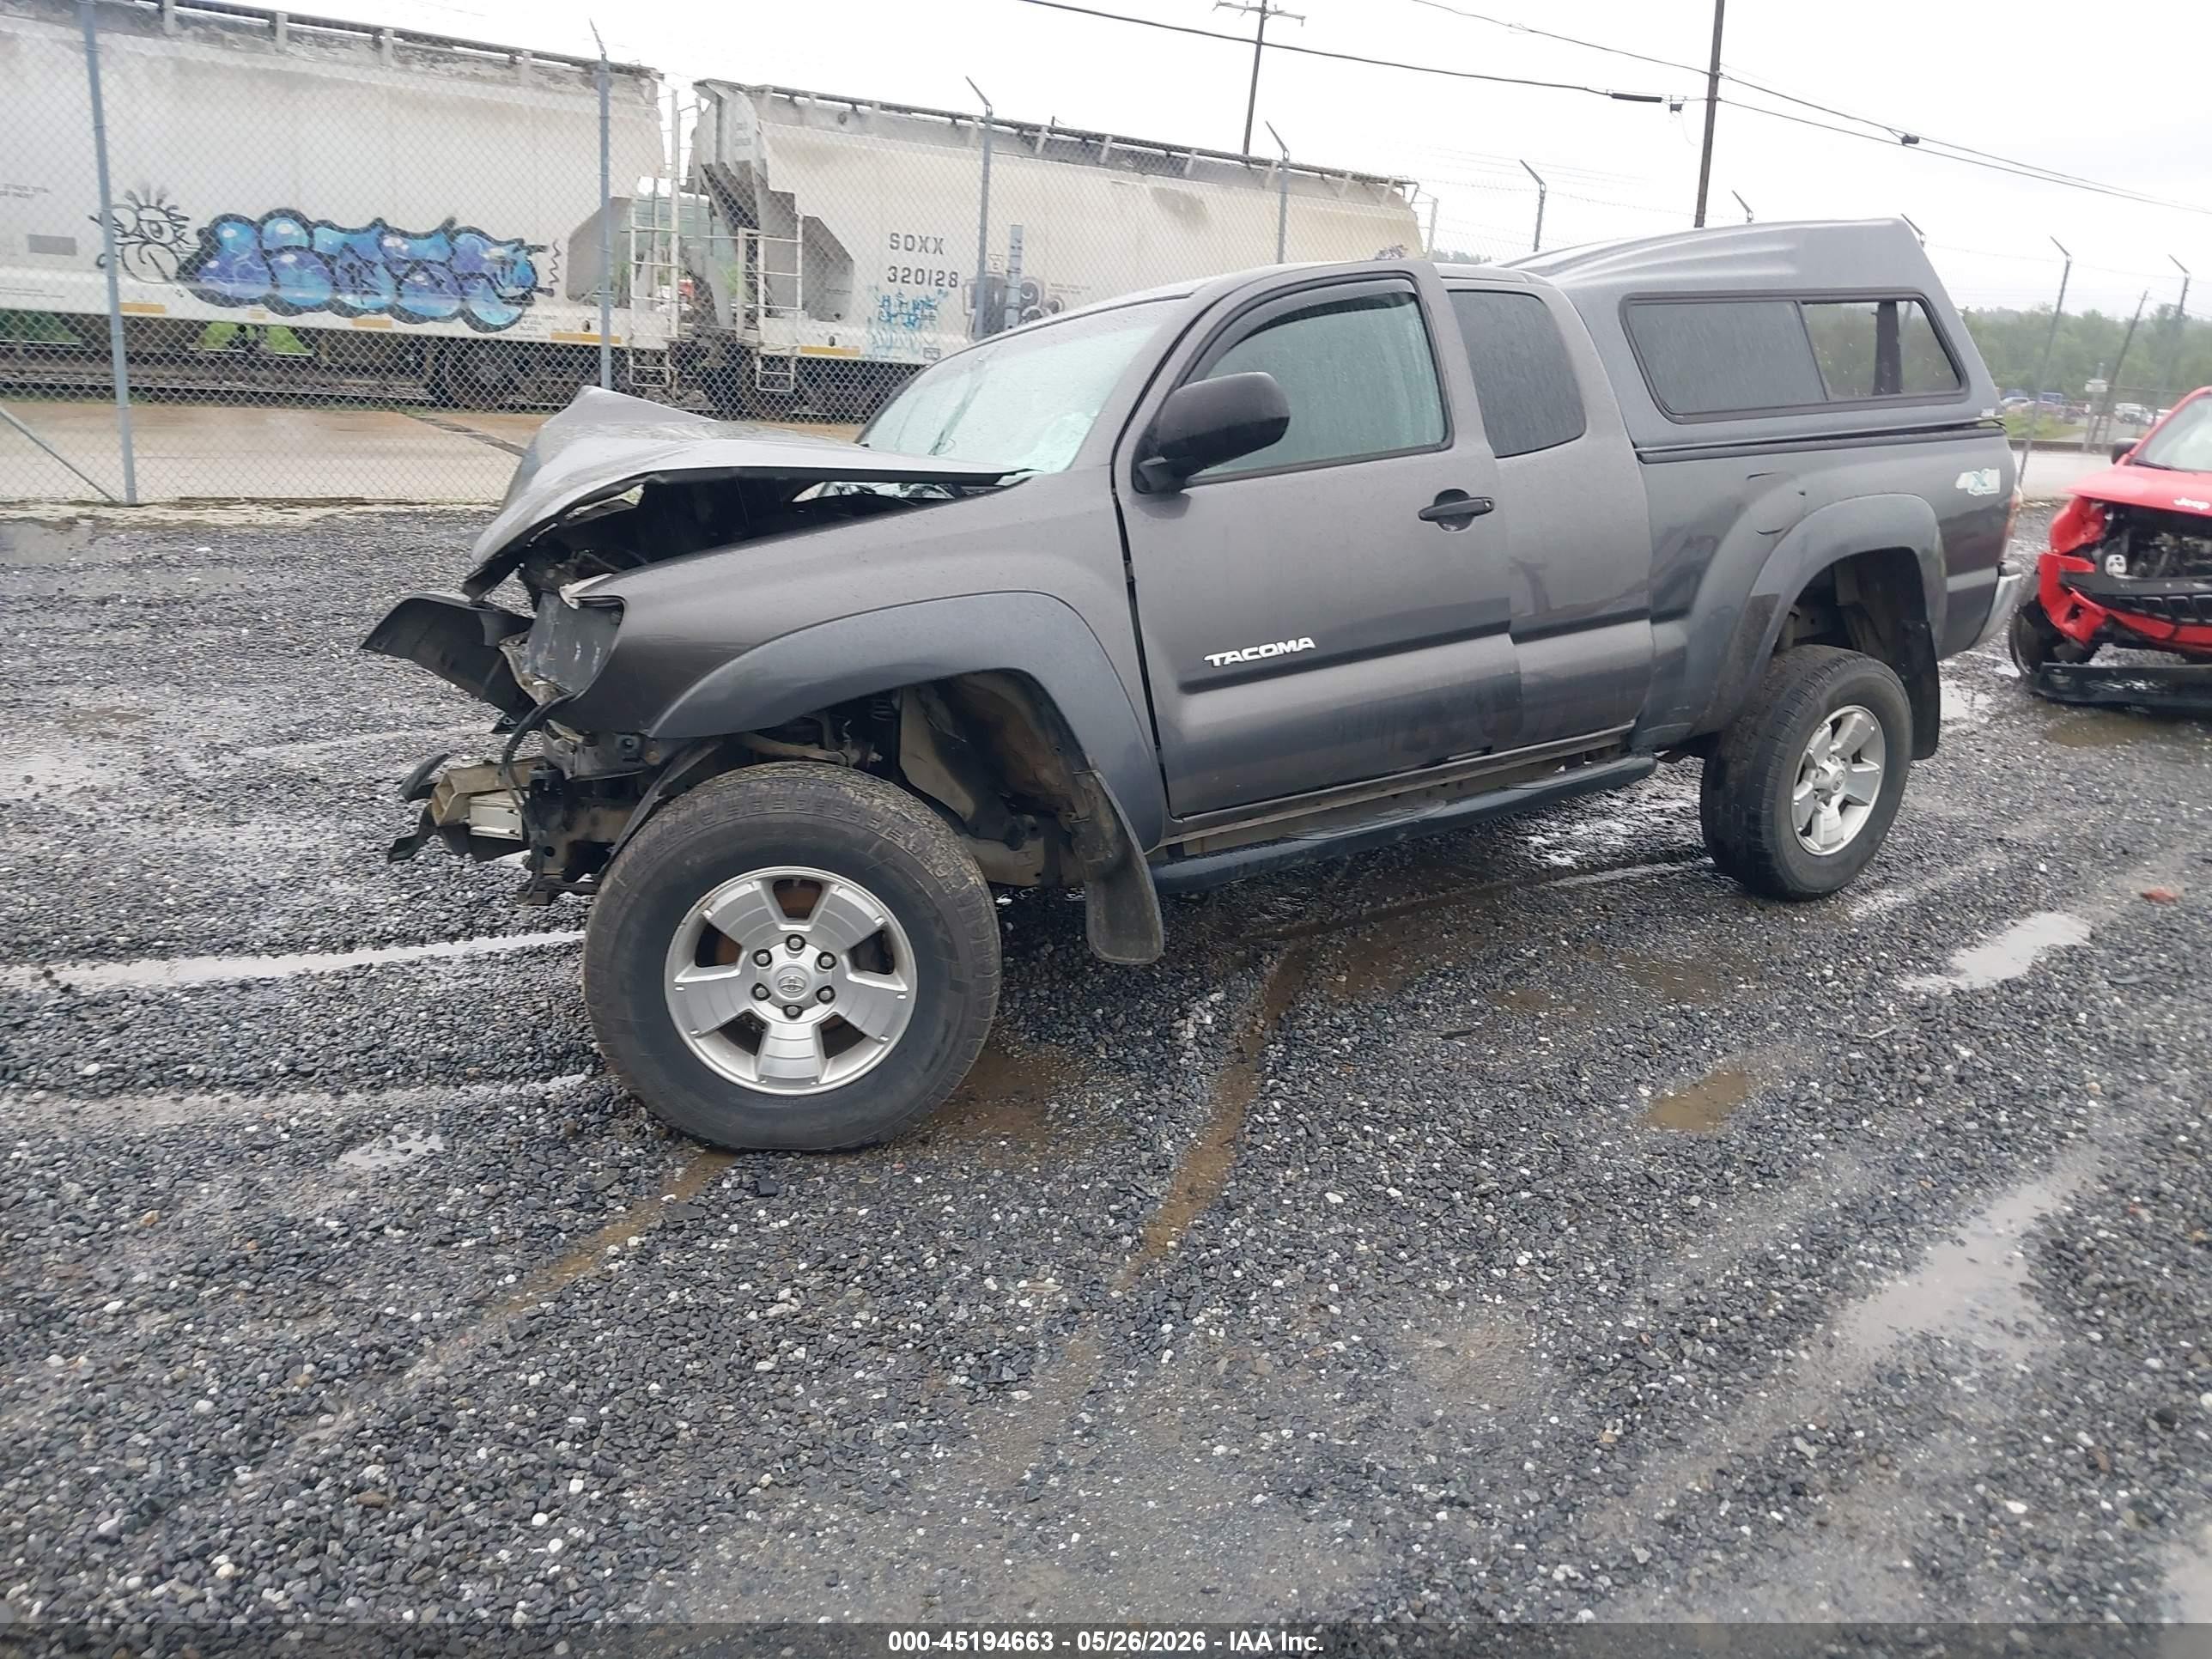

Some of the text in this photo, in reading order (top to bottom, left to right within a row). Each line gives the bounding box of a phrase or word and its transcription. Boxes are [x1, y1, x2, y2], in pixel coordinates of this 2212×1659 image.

[890, 233, 944, 255] SOXX
[887, 265, 958, 288] 320128
[2172, 496, 2210, 511] Jeep
[1203, 636, 1316, 667] TACOMA
